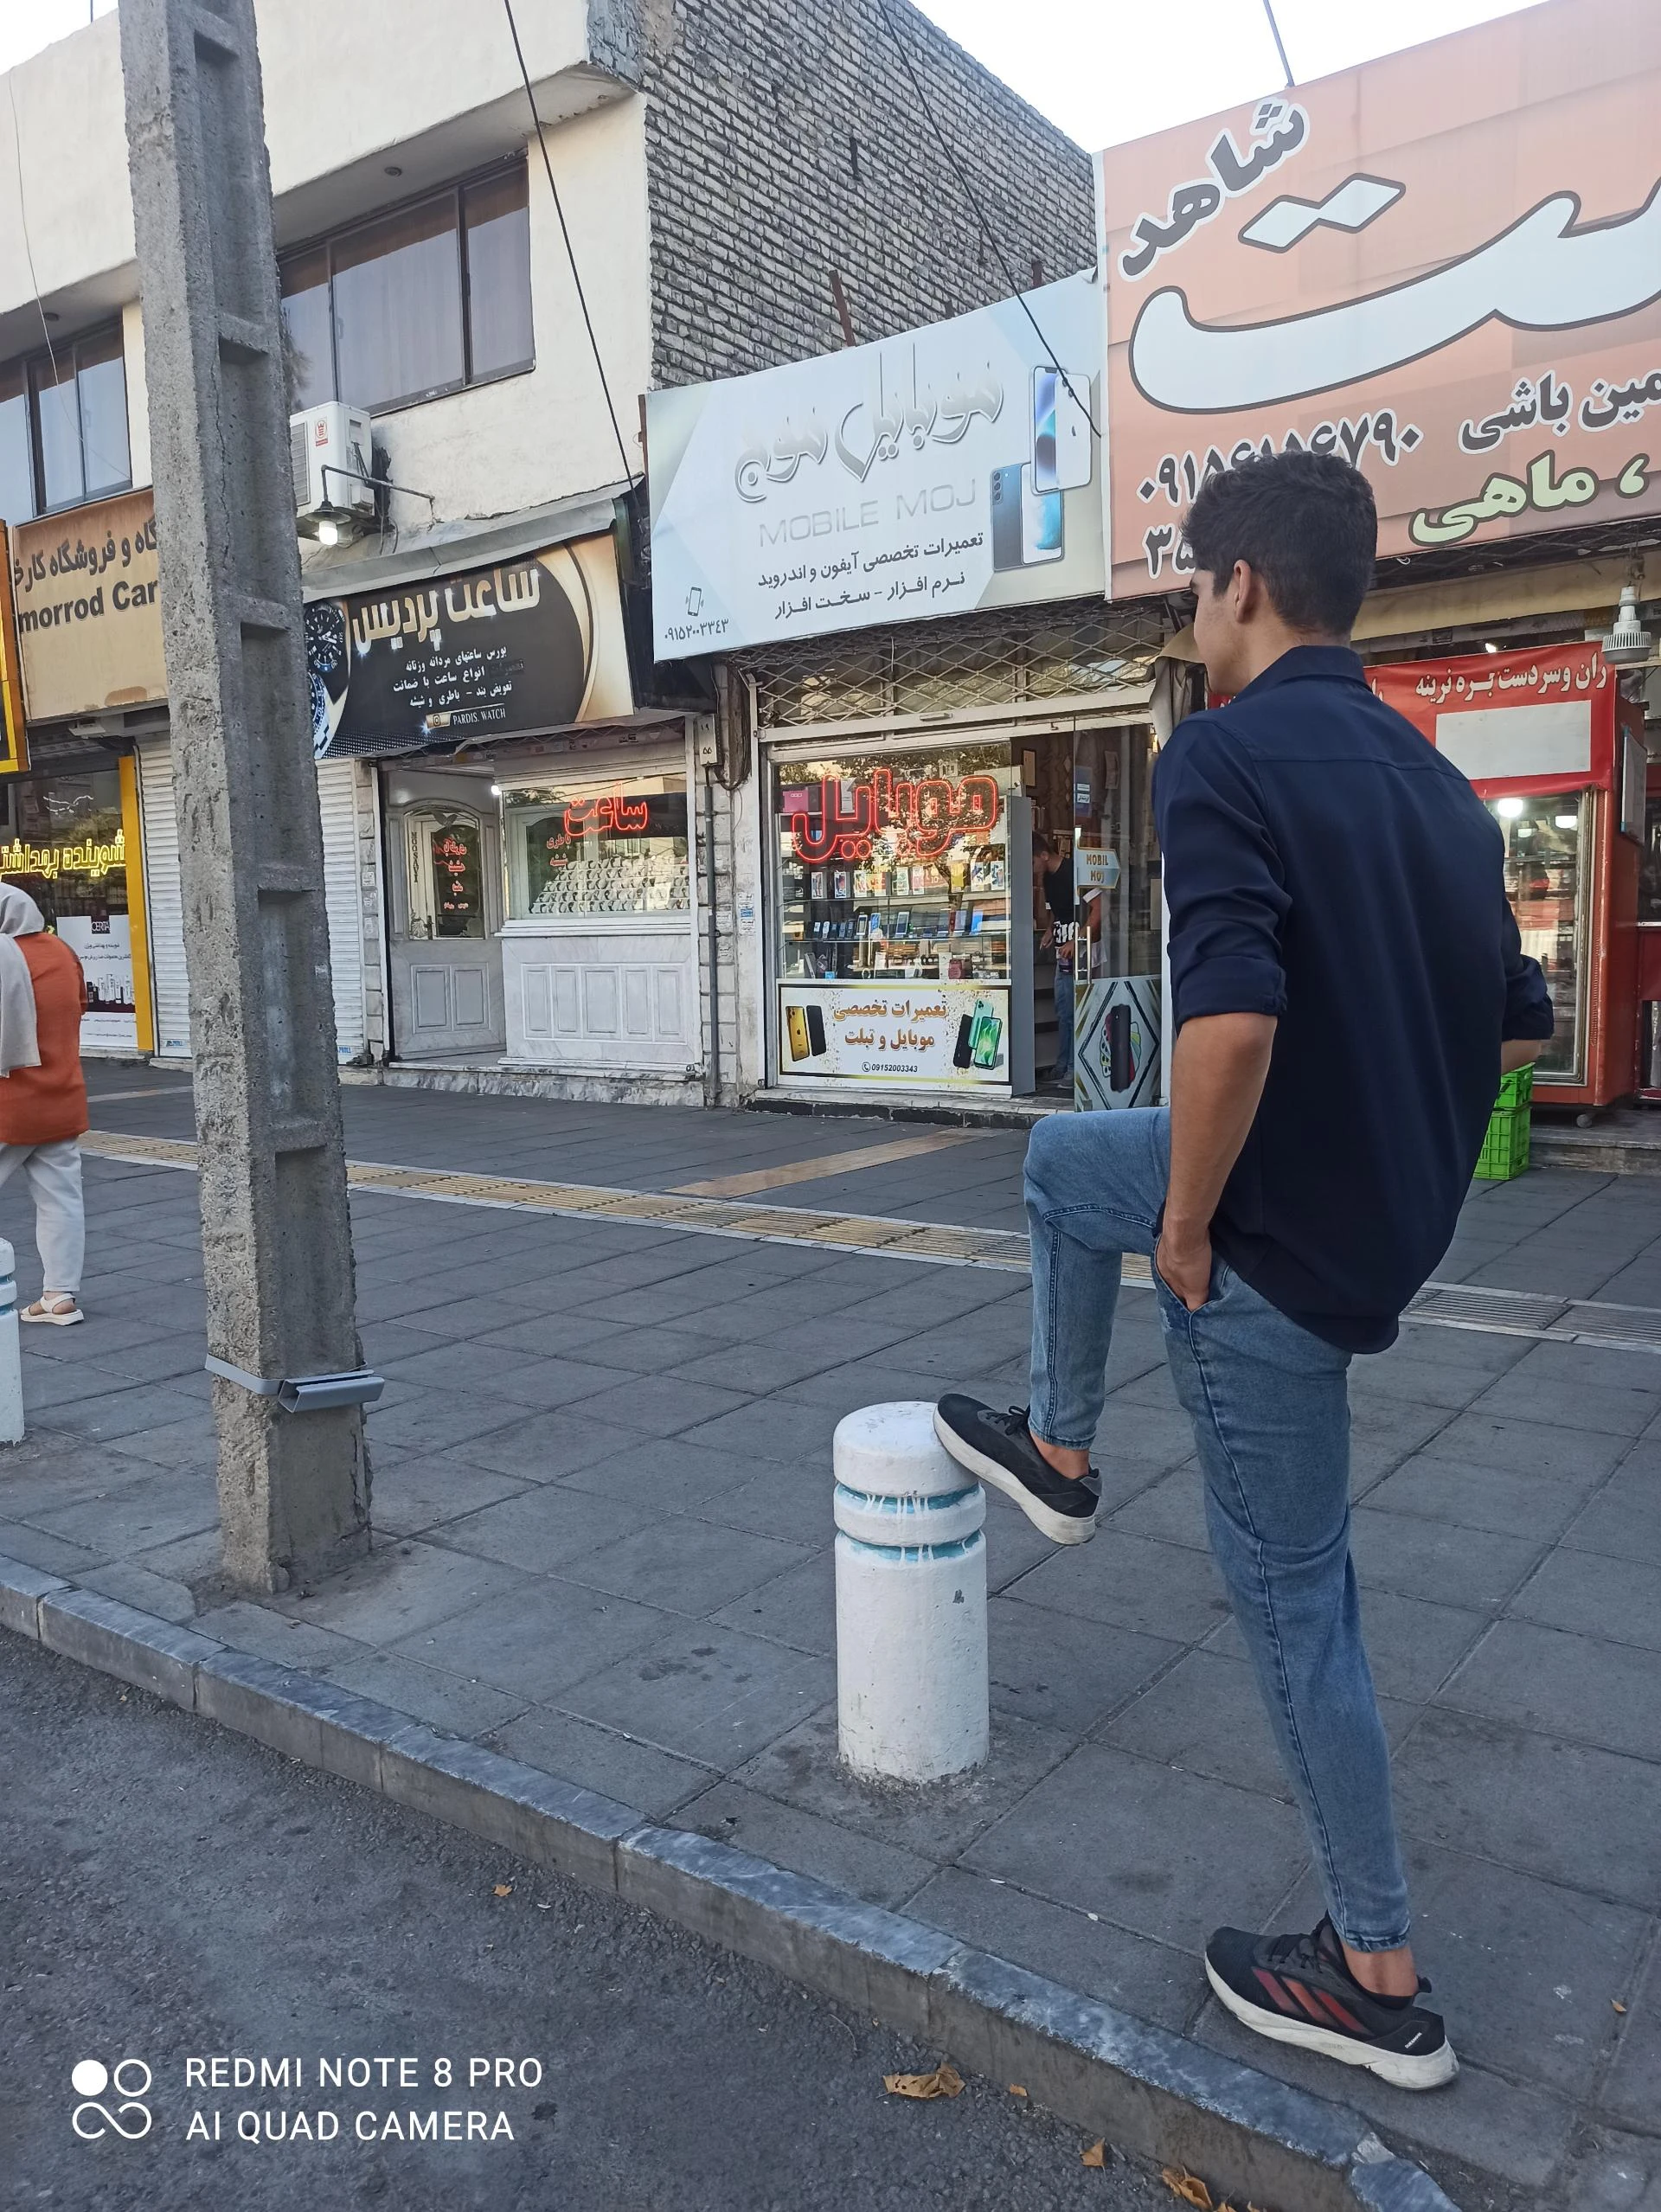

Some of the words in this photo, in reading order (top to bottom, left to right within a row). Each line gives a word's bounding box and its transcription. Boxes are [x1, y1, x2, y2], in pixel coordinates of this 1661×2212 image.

[1118, 97, 1311, 281] شاهد
[1461, 372, 1573, 452] باشی
[1409, 451, 1596, 546] ماهی
[760, 500, 880, 547] MOBILE
[896, 479, 976, 519] MOJ
[50, 530, 117, 577] فروشگاه
[923, 532, 984, 557] تعمیرات
[821, 551, 859, 580] آیفون
[863, 545, 920, 573] تخصصی
[758, 565, 806, 588] اندروید
[888, 576, 927, 600] افزار
[932, 572, 965, 598] نرم
[444, 567, 542, 623] ساعت
[815, 590, 870, 609] سخت
[775, 597, 811, 619] افزار
[352, 588, 442, 654] پردیس
[434, 671, 458, 685] ساعت
[1575, 651, 1606, 689] ران
[480, 708, 506, 721] WATCH
[564, 781, 649, 837] ساعت
[792, 768, 998, 862] موبایل
[0, 838, 60, 881] بهداشت
[63, 829, 126, 877] شوینده
[1086, 854, 1108, 866] MOBIL
[1090, 870, 1105, 883] MOJ
[833, 999, 888, 1021] تخصصی
[891, 999, 948, 1022] تعمیرات
[844, 1027, 875, 1048] تبلت
[878, 1035, 886, 1051] و
[890, 1029, 934, 1051] موبایل
[871, 1063, 918, 1073] 09152003343
